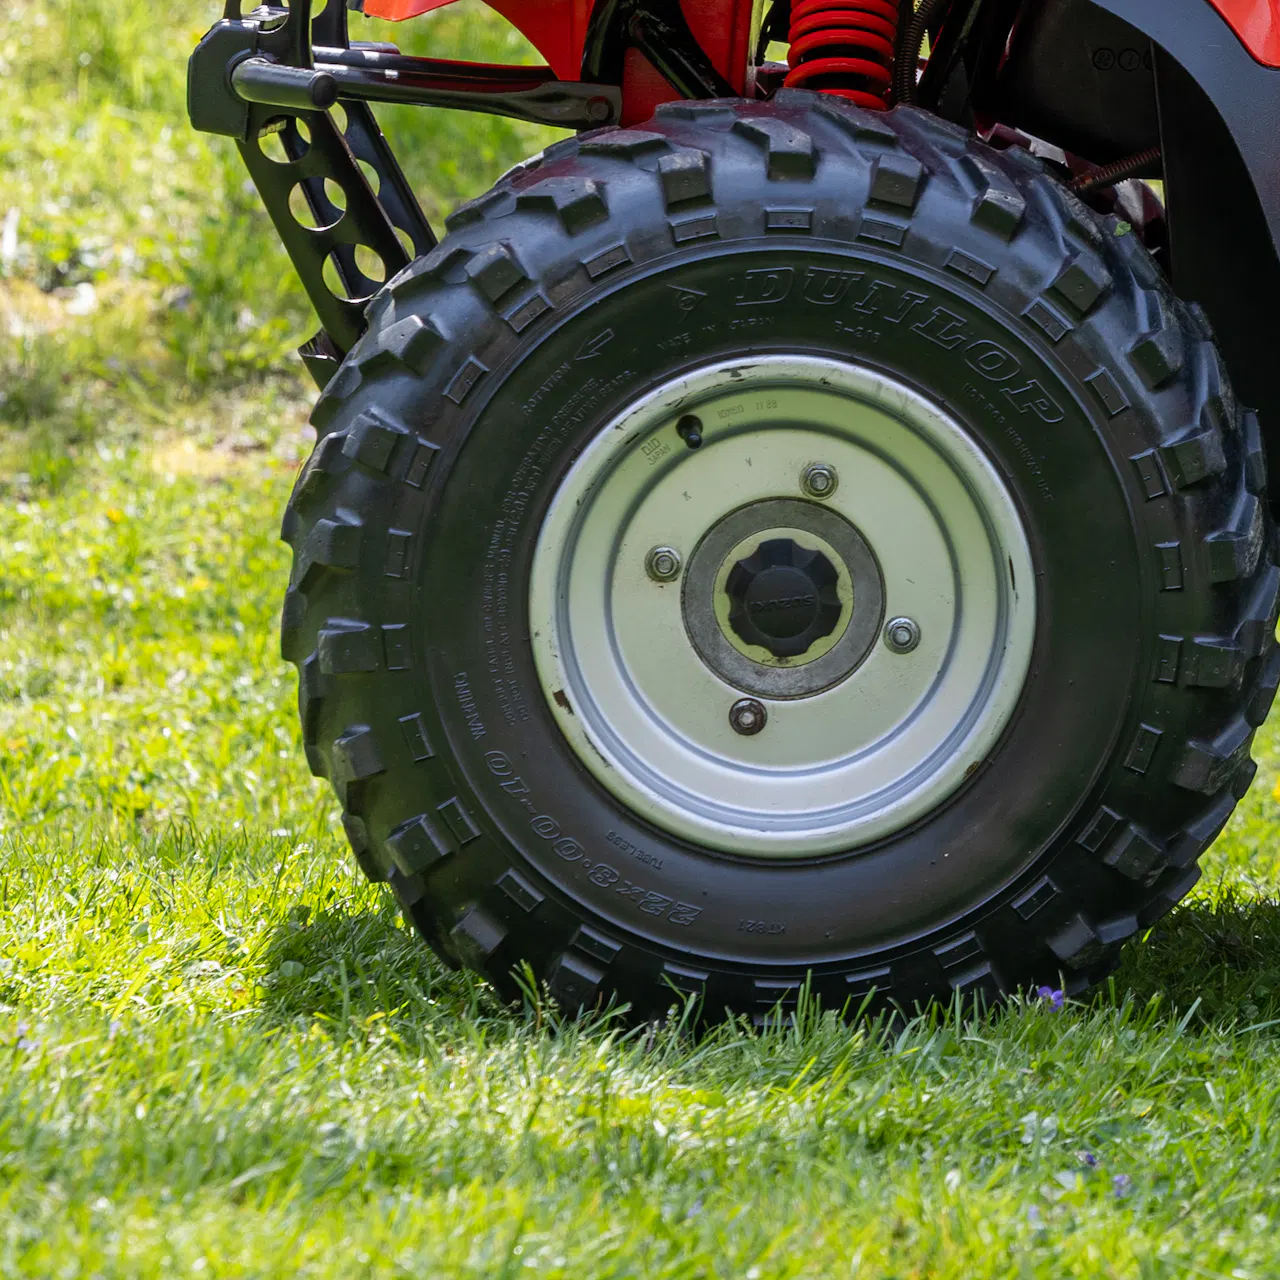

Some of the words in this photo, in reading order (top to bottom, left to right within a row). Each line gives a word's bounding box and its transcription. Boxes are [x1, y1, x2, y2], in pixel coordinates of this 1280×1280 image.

[655, 330, 692, 354] MADE
[727, 314, 775, 331] JAPAN
[731, 265, 1066, 424] DUNLOP
[519, 360, 573, 417] ROTATION
[641, 437, 661, 456] DID
[647, 444, 671, 466] JAPAN
[958, 378, 987, 406] NOT
[981, 400, 1008, 428] FOR
[1002, 424, 1043, 478] HIGHWAY
[453, 671, 488, 740] WARNING
